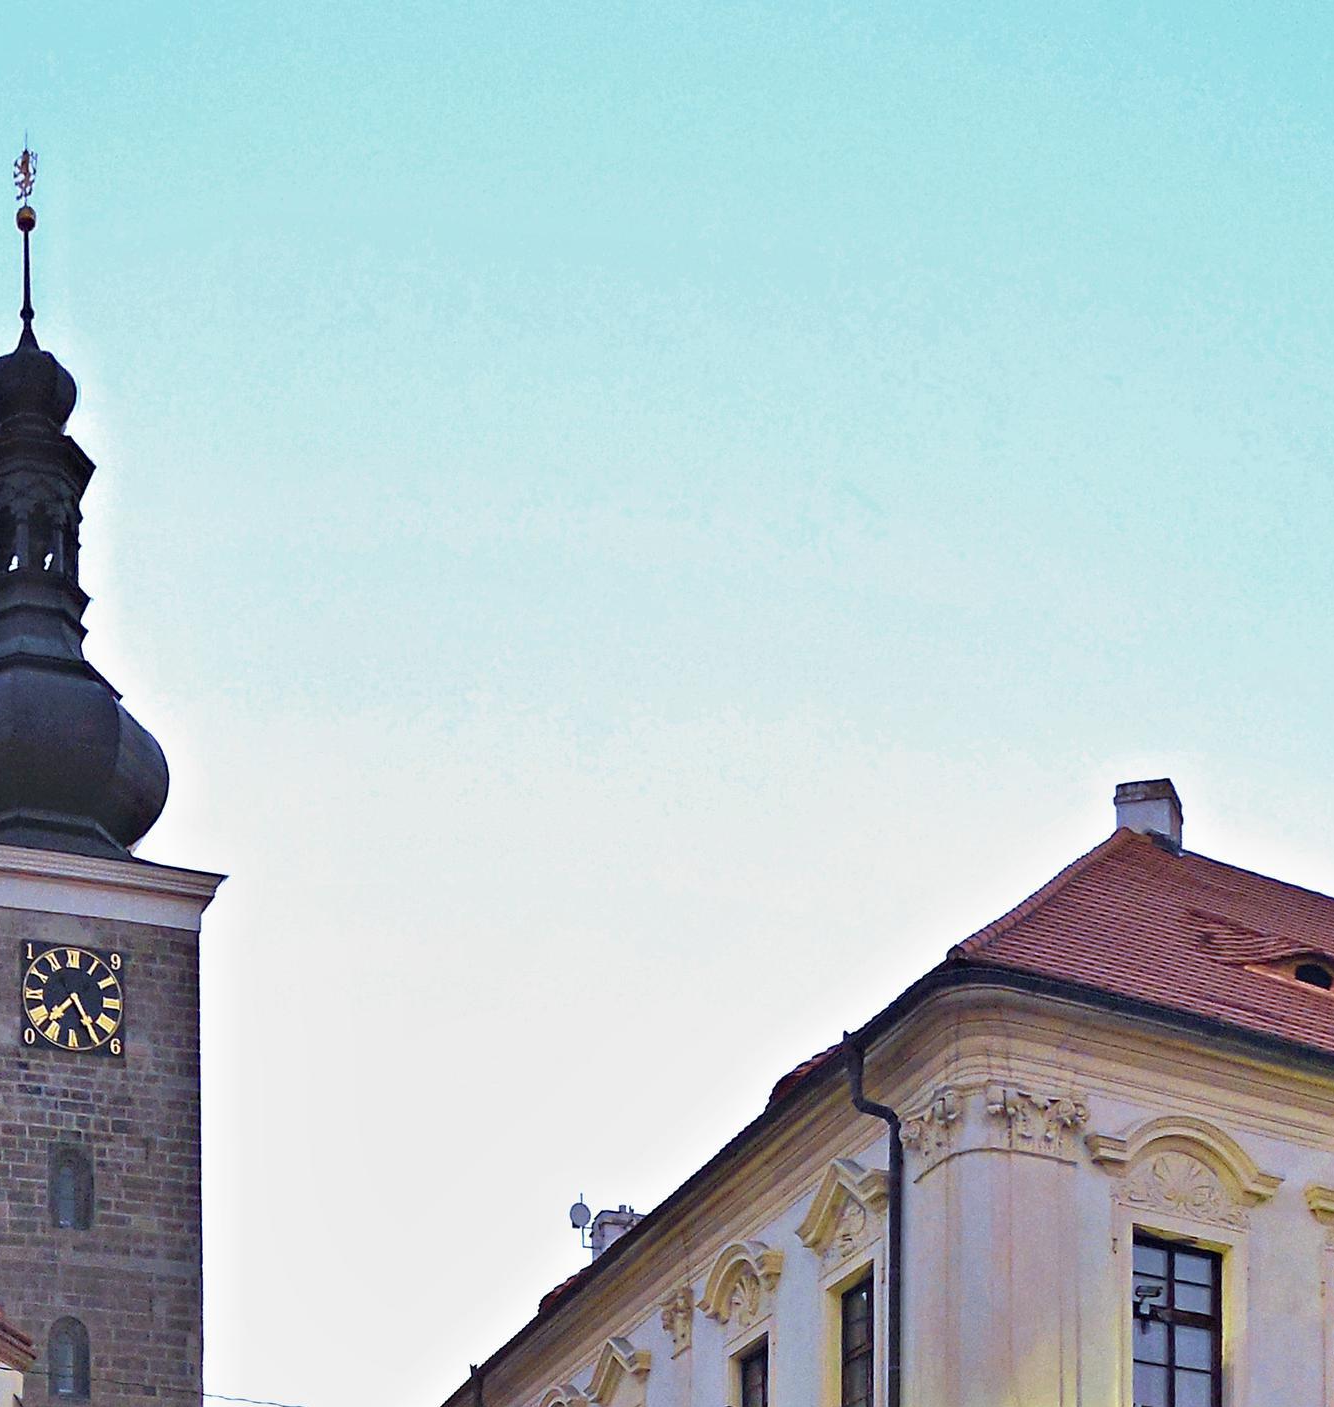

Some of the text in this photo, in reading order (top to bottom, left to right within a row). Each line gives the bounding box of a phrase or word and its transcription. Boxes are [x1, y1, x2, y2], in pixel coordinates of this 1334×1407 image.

[27, 943, 33, 960] 1
[110, 953, 121, 970] 9
[24, 1027, 36, 1045] 0
[110, 1038, 121, 1055] 6
